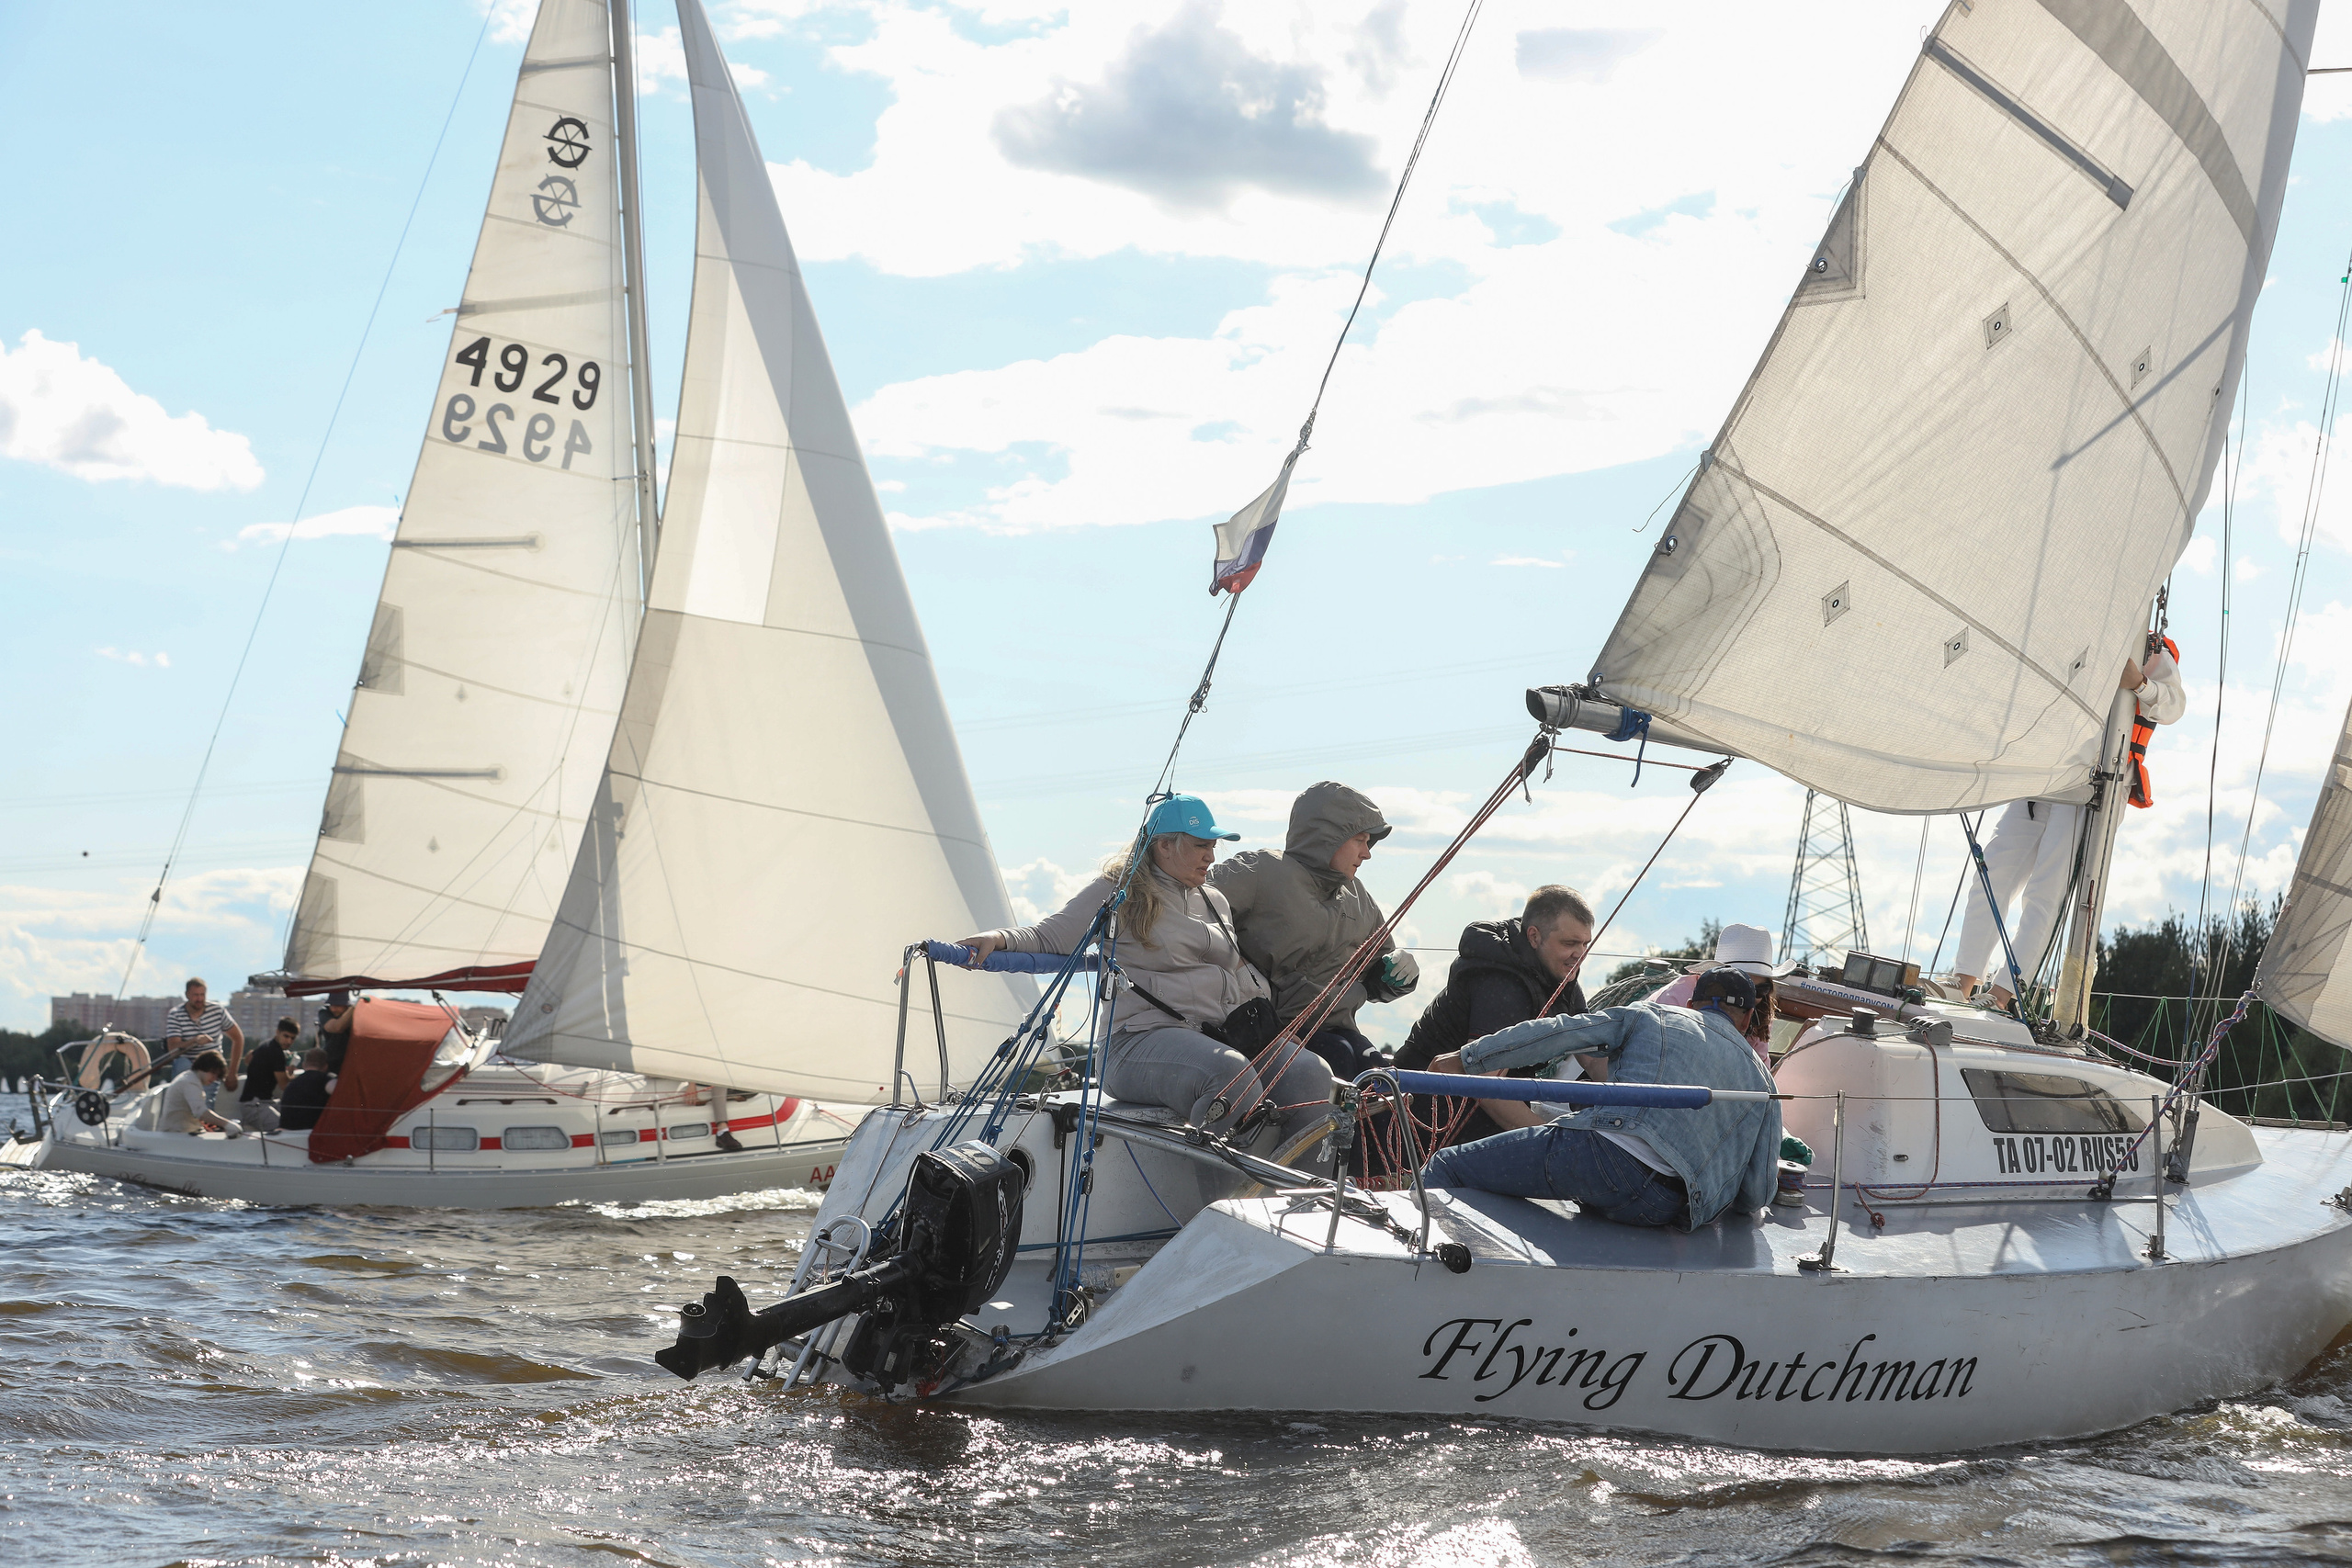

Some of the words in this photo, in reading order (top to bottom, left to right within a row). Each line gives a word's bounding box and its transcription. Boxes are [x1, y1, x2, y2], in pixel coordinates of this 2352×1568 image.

[456, 336, 602, 411] 4929
[1993, 1137, 2021, 1174] TA
[2023, 1136, 2078, 1173] 07-02
[1419, 1318, 1647, 1410] Flying
[1668, 1334, 1978, 1402] Dutchman
